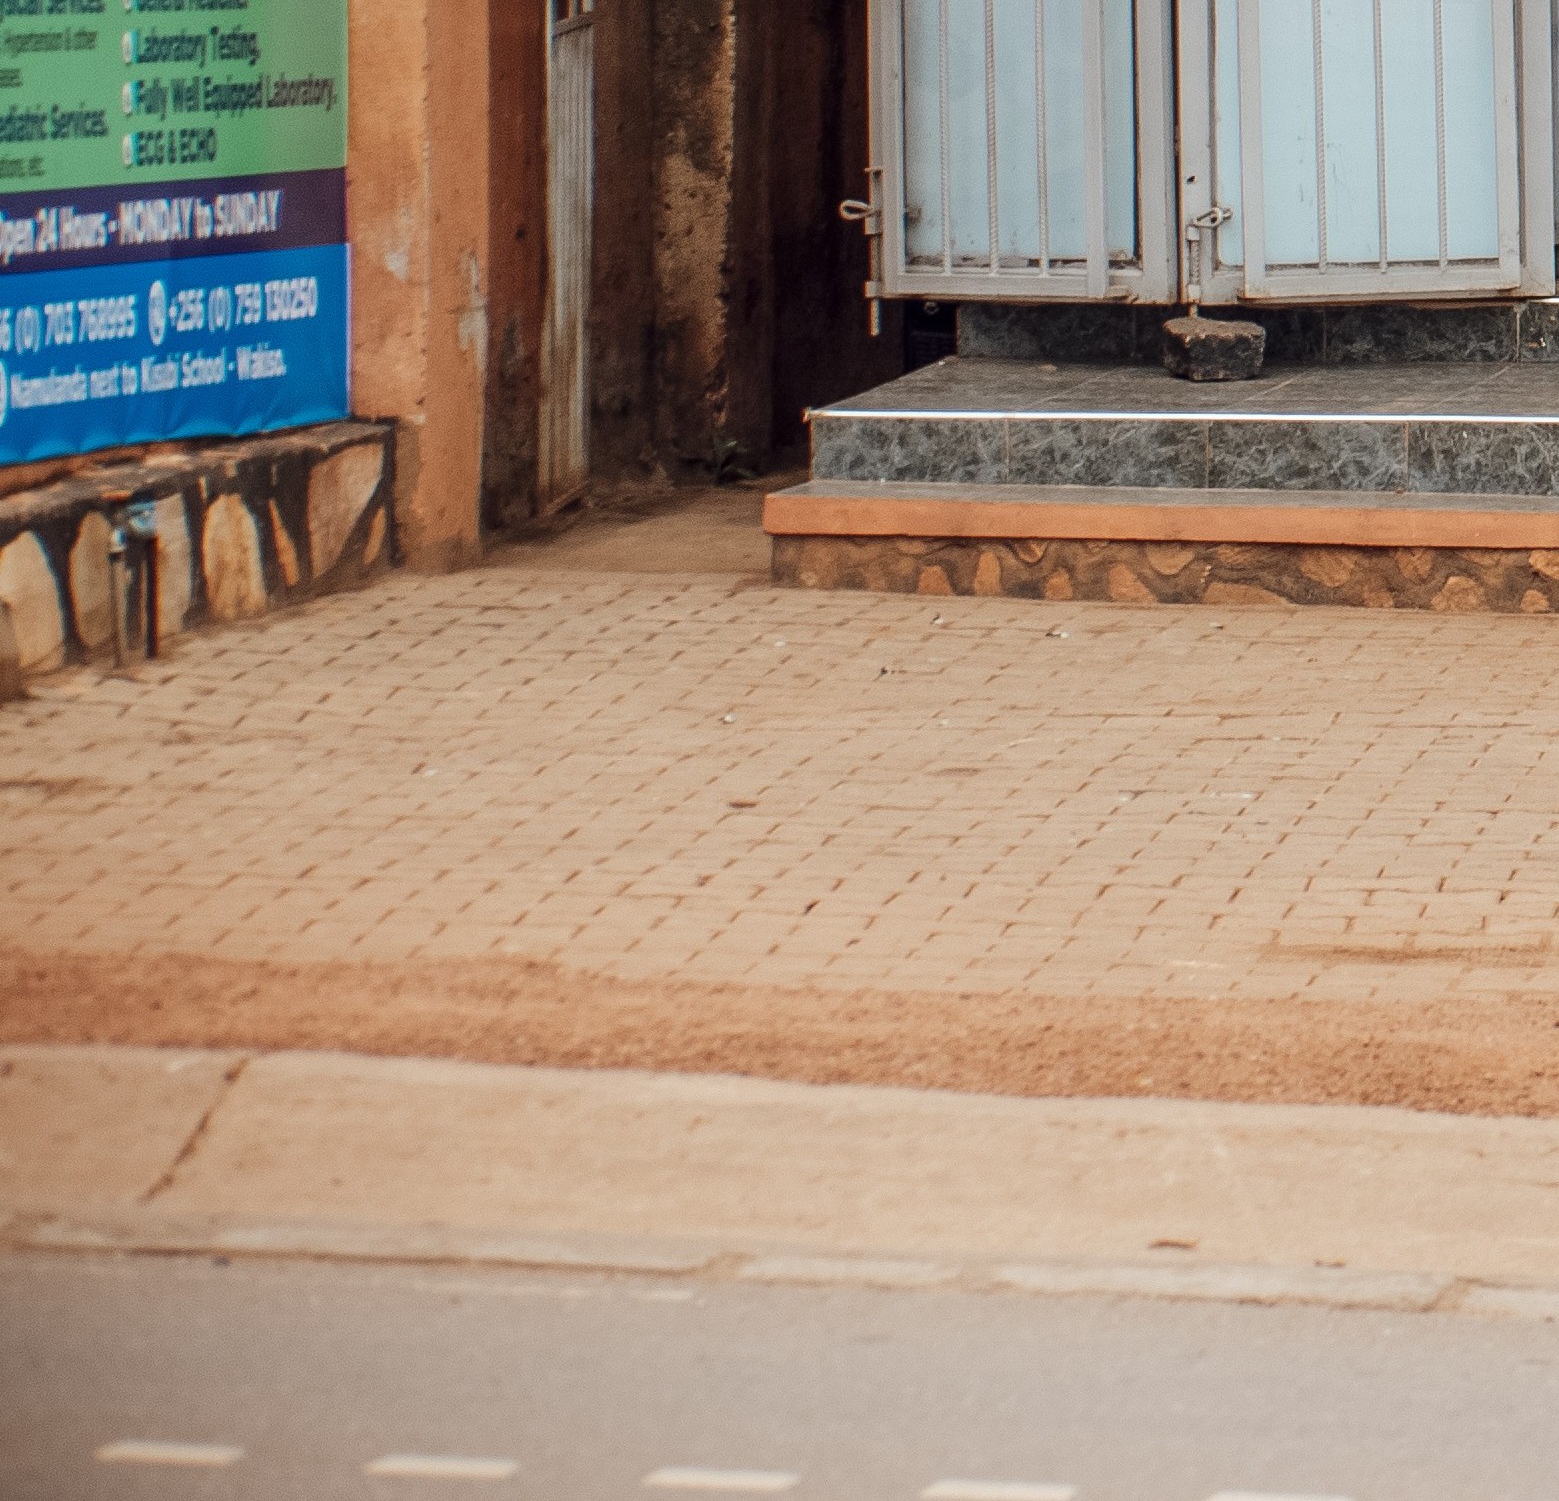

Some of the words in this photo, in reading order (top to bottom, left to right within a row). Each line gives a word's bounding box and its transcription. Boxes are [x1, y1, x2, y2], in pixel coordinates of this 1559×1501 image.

[136, 27, 206, 68] Laboratory
[36, 204, 59, 252] 24
[59, 203, 107, 250] Hours
[118, 198, 194, 244] MONDAY
[214, 191, 283, 237] SUNDAY
